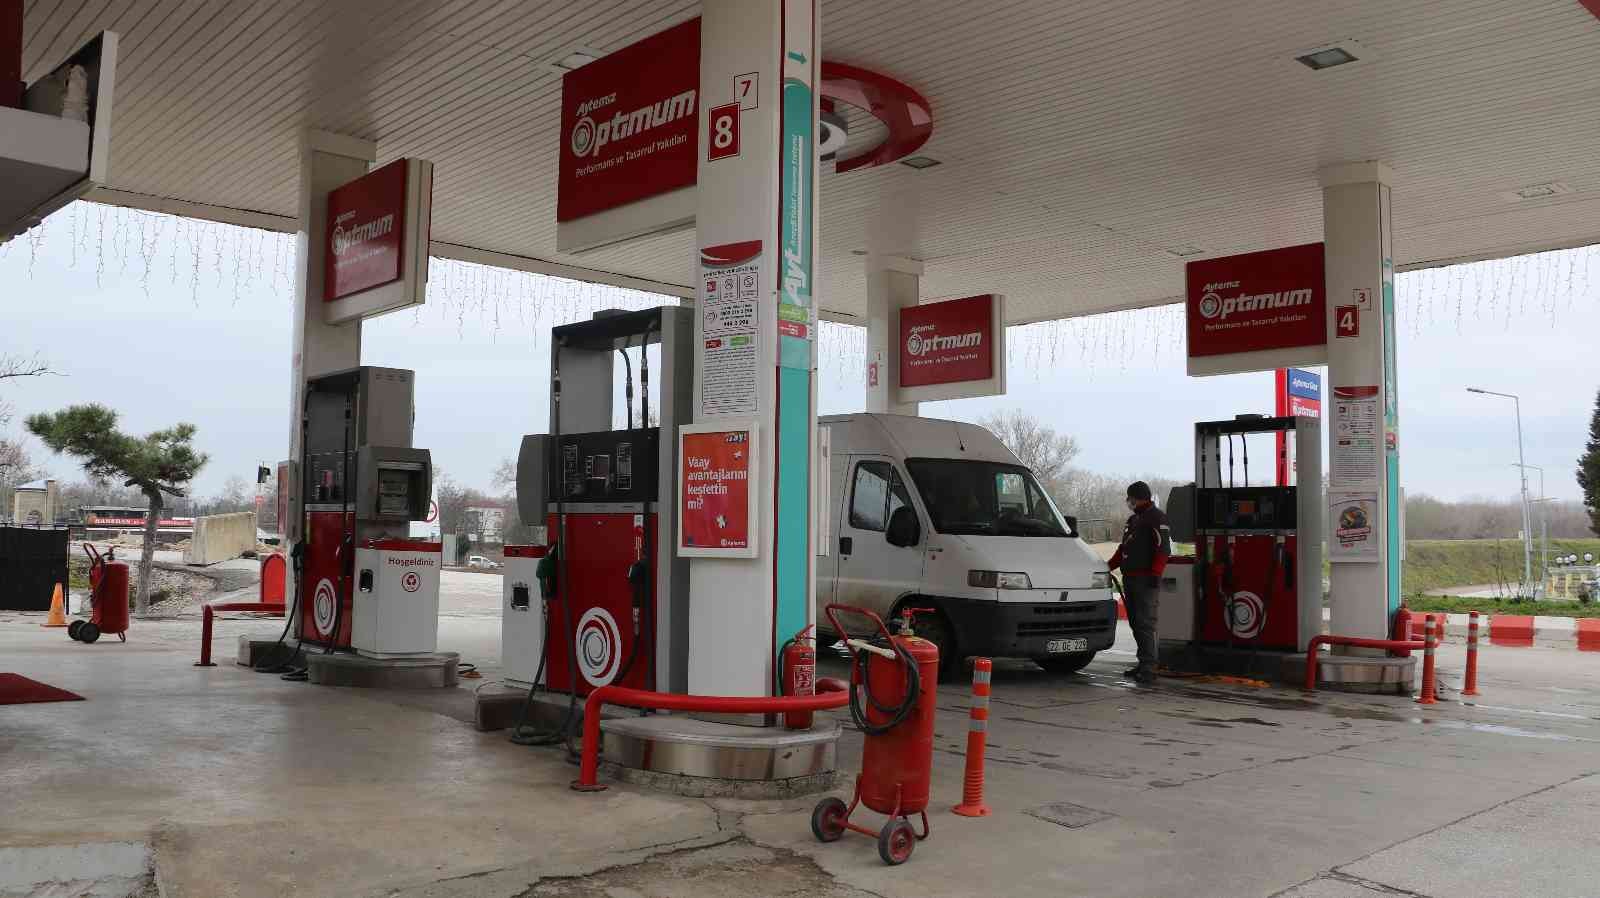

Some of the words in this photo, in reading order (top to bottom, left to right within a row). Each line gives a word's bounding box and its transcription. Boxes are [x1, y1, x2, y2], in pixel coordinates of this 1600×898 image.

[740, 79, 752, 97] 7
[571, 89, 697, 157] Optimum
[714, 115, 733, 149] 8
[575, 156, 615, 178] Performans
[615, 156, 625, 164] ve
[626, 142, 655, 161] Tasarruf
[656, 134, 688, 151] Yakıtları
[1202, 280, 1241, 293] Aytemiz
[1199, 288, 1313, 320] Optimum
[1359, 292, 1366, 303] 3
[1340, 311, 1355, 331] 4
[907, 332, 982, 356] Optimum
[687, 456, 710, 470] Vaay
[387, 556, 435, 567] Hoşgeldiniz
